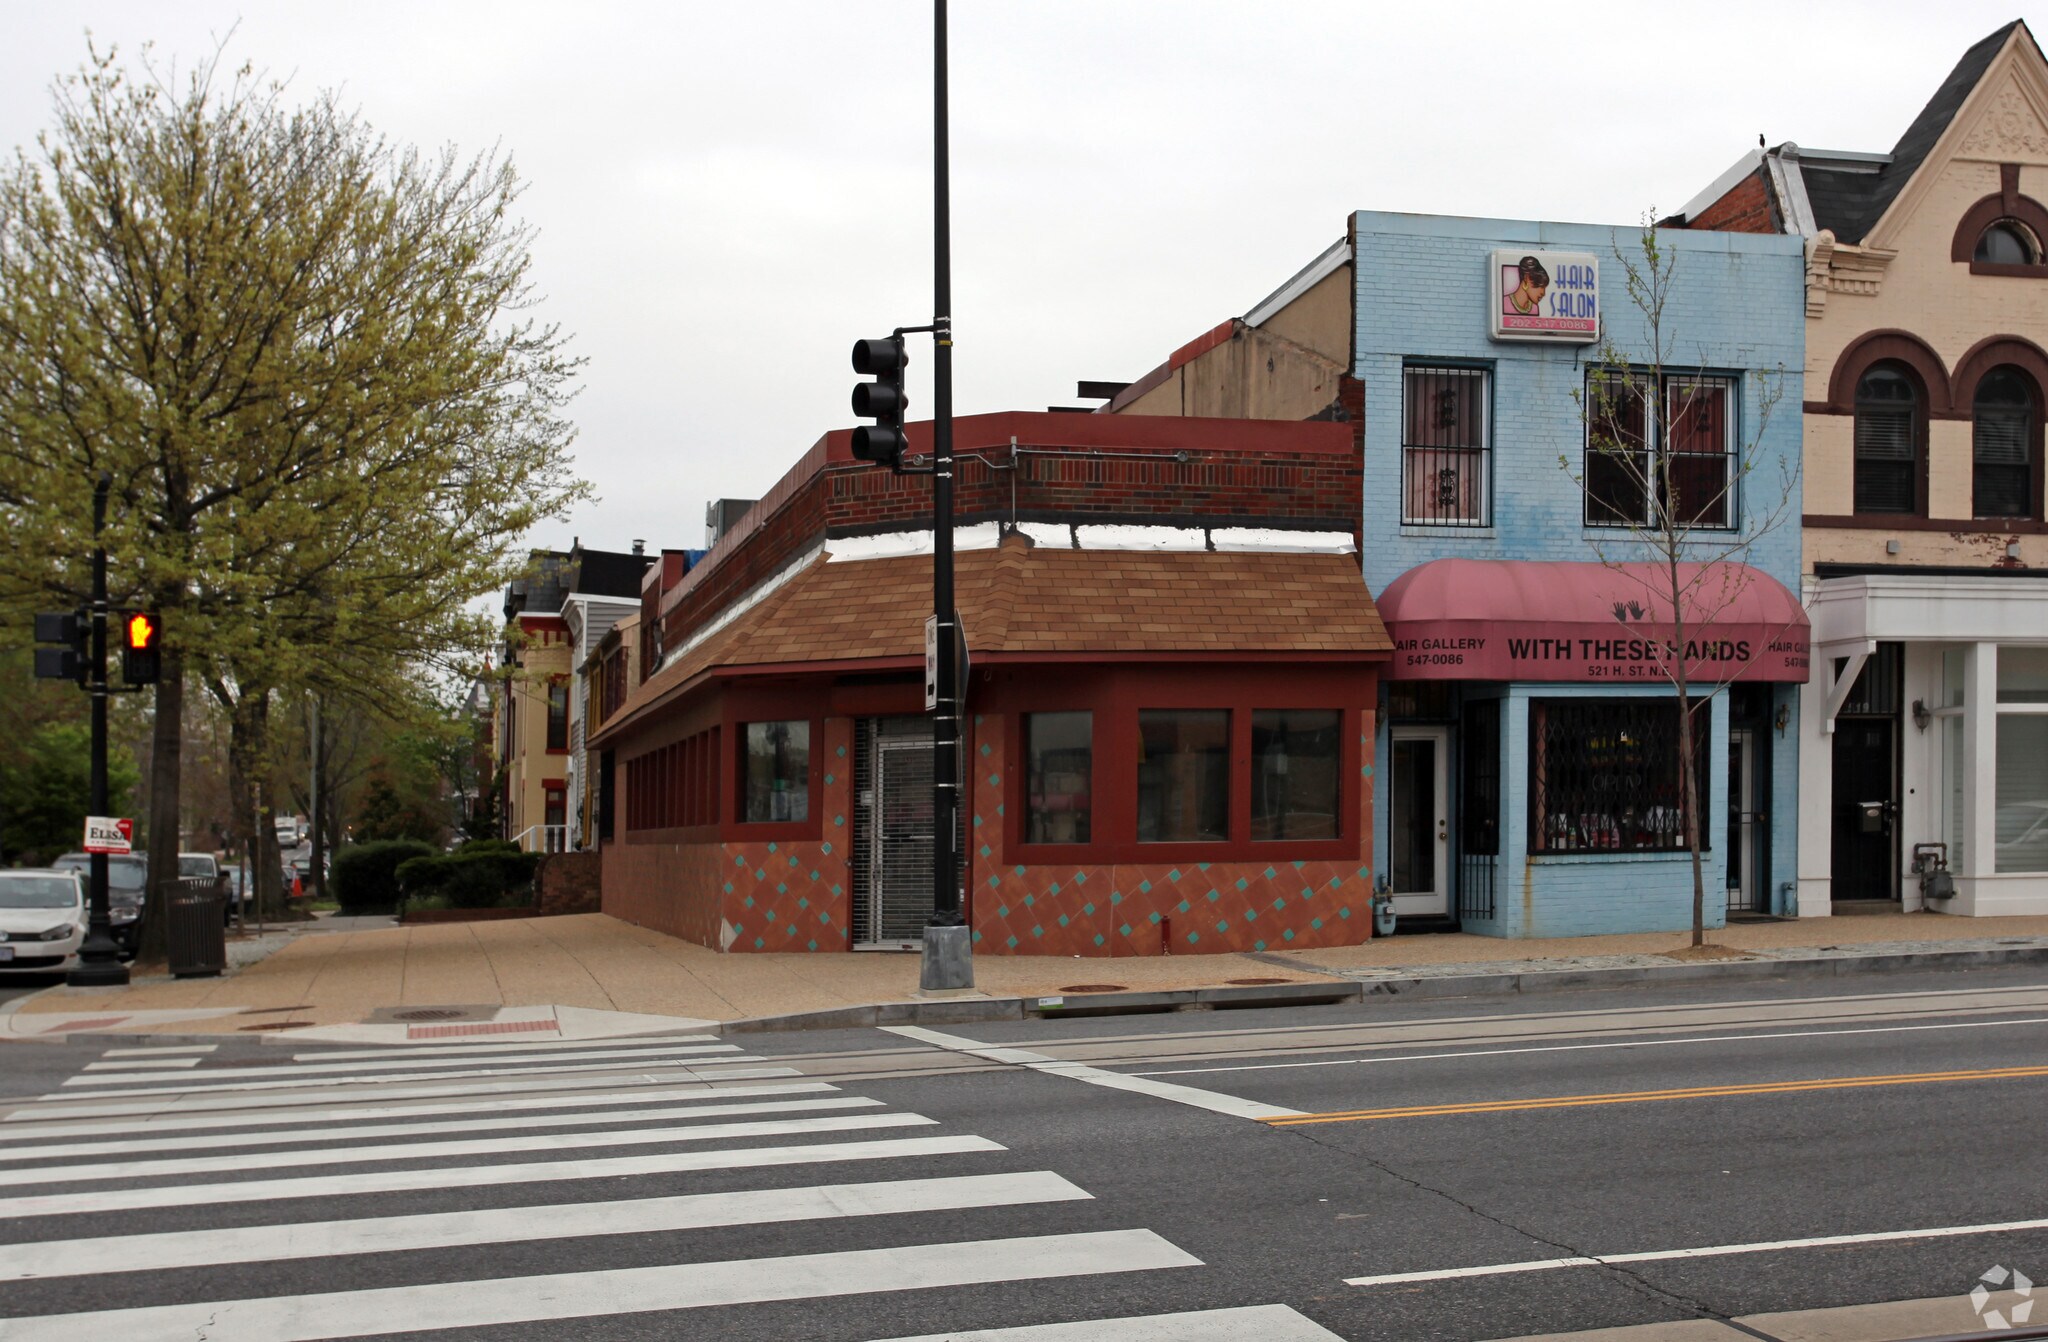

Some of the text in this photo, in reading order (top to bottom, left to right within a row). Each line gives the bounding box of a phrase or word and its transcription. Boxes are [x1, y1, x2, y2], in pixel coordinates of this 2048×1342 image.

[1554, 264, 1594, 290] HAIR
[1549, 292, 1595, 318] SALON
[1393, 638, 1486, 651] AIR GALLERY
[1508, 638, 1571, 660] WITH
[1579, 639, 1658, 661] THESE
[1768, 641, 1793, 653] HAIR
[1407, 654, 1464, 666] 547-0086
[1588, 665, 1608, 676] 521
[1613, 666, 1625, 676] H.
[1629, 666, 1645, 676] ST.
